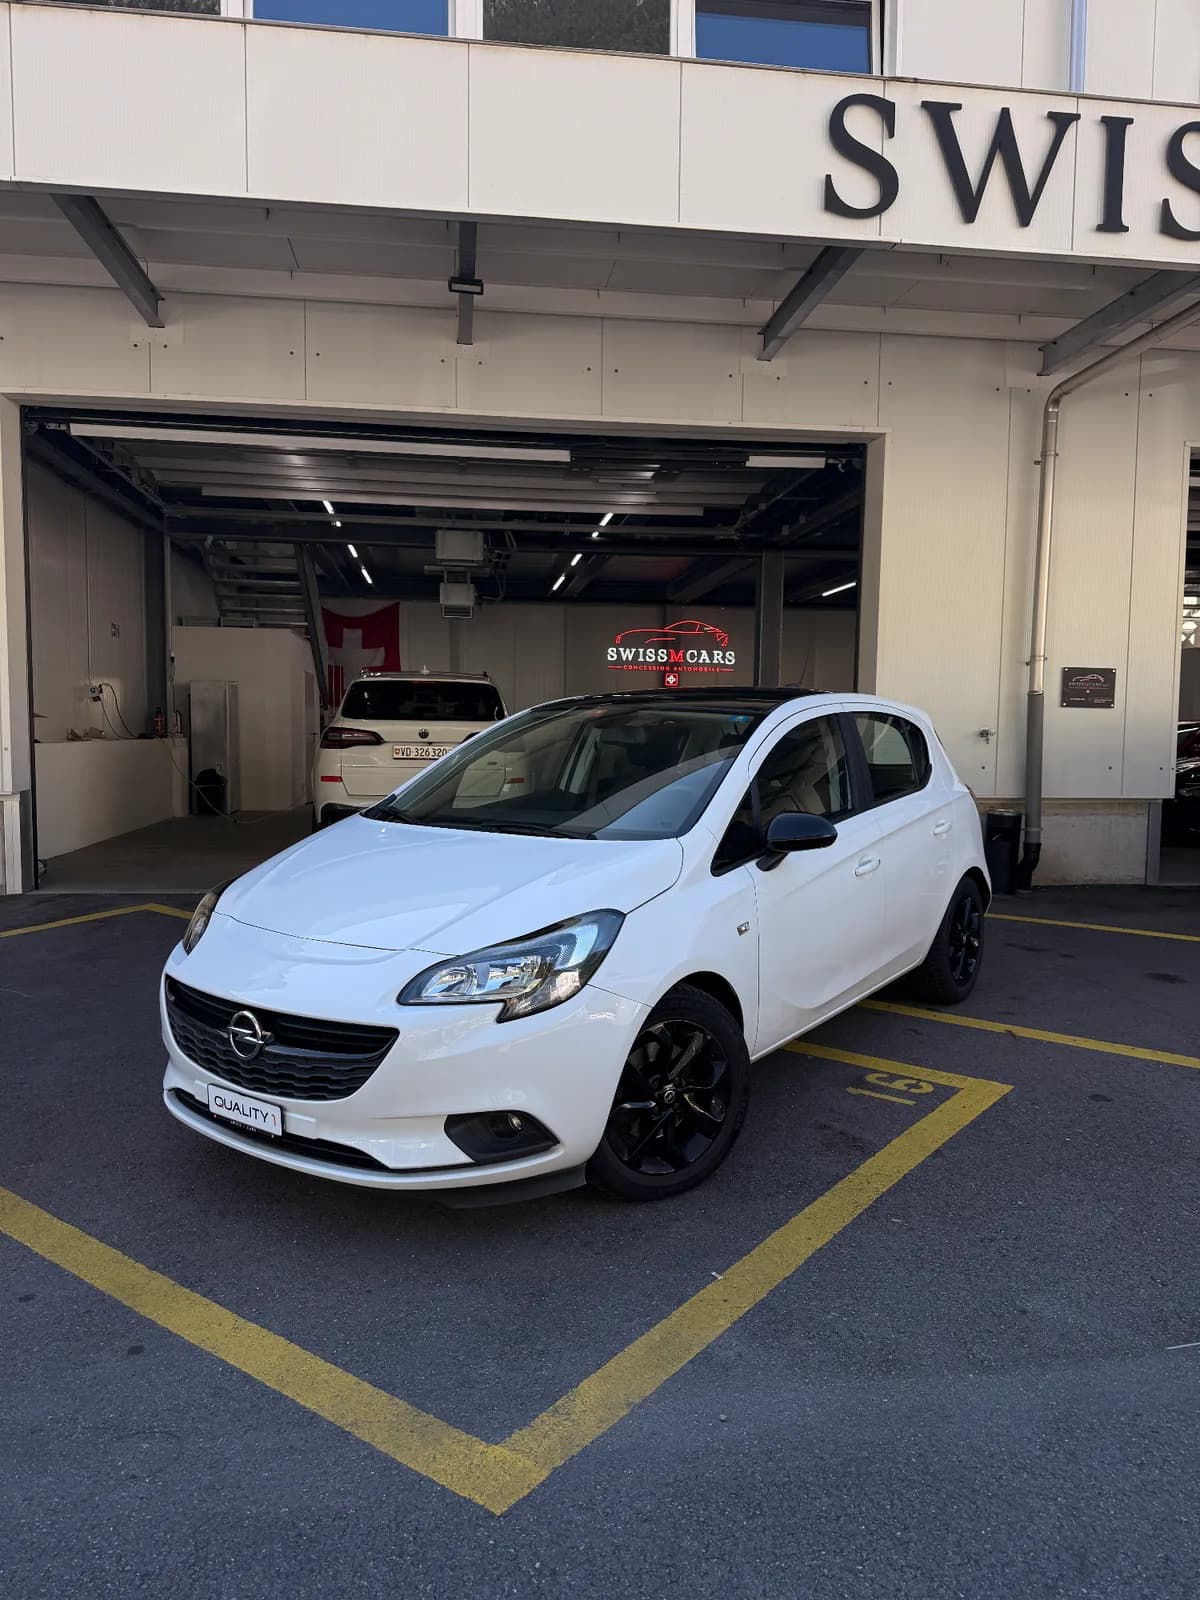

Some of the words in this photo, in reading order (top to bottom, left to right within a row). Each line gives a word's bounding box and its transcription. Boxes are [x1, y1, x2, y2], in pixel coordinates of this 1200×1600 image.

[607, 647, 736, 665] SWISSMCARS
[400, 747, 411, 757] VD
[214, 1095, 269, 1123] QUALITY
